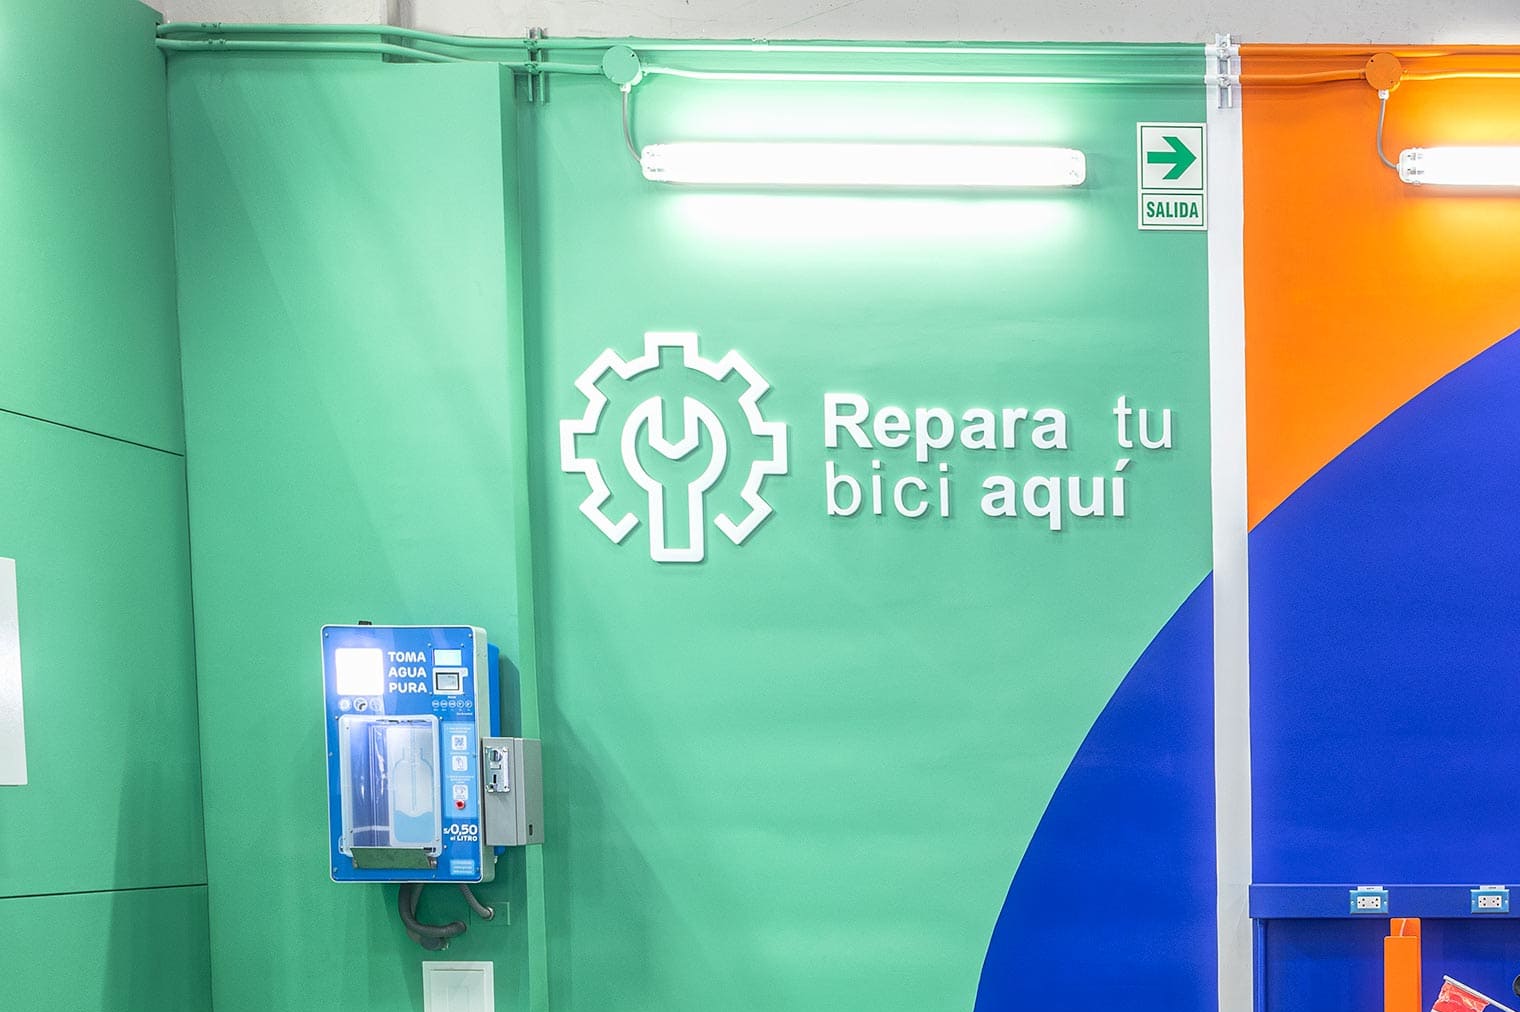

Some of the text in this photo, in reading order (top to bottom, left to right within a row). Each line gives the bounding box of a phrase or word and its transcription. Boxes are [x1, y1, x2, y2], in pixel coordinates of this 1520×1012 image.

[1146, 201, 1199, 218] SALIDA
[823, 392, 1172, 463] Repara tu
[826, 458, 1131, 531] bici aquí
[387, 651, 427, 663] TOMA
[388, 666, 428, 678] AGUA
[389, 682, 428, 693] PURA
